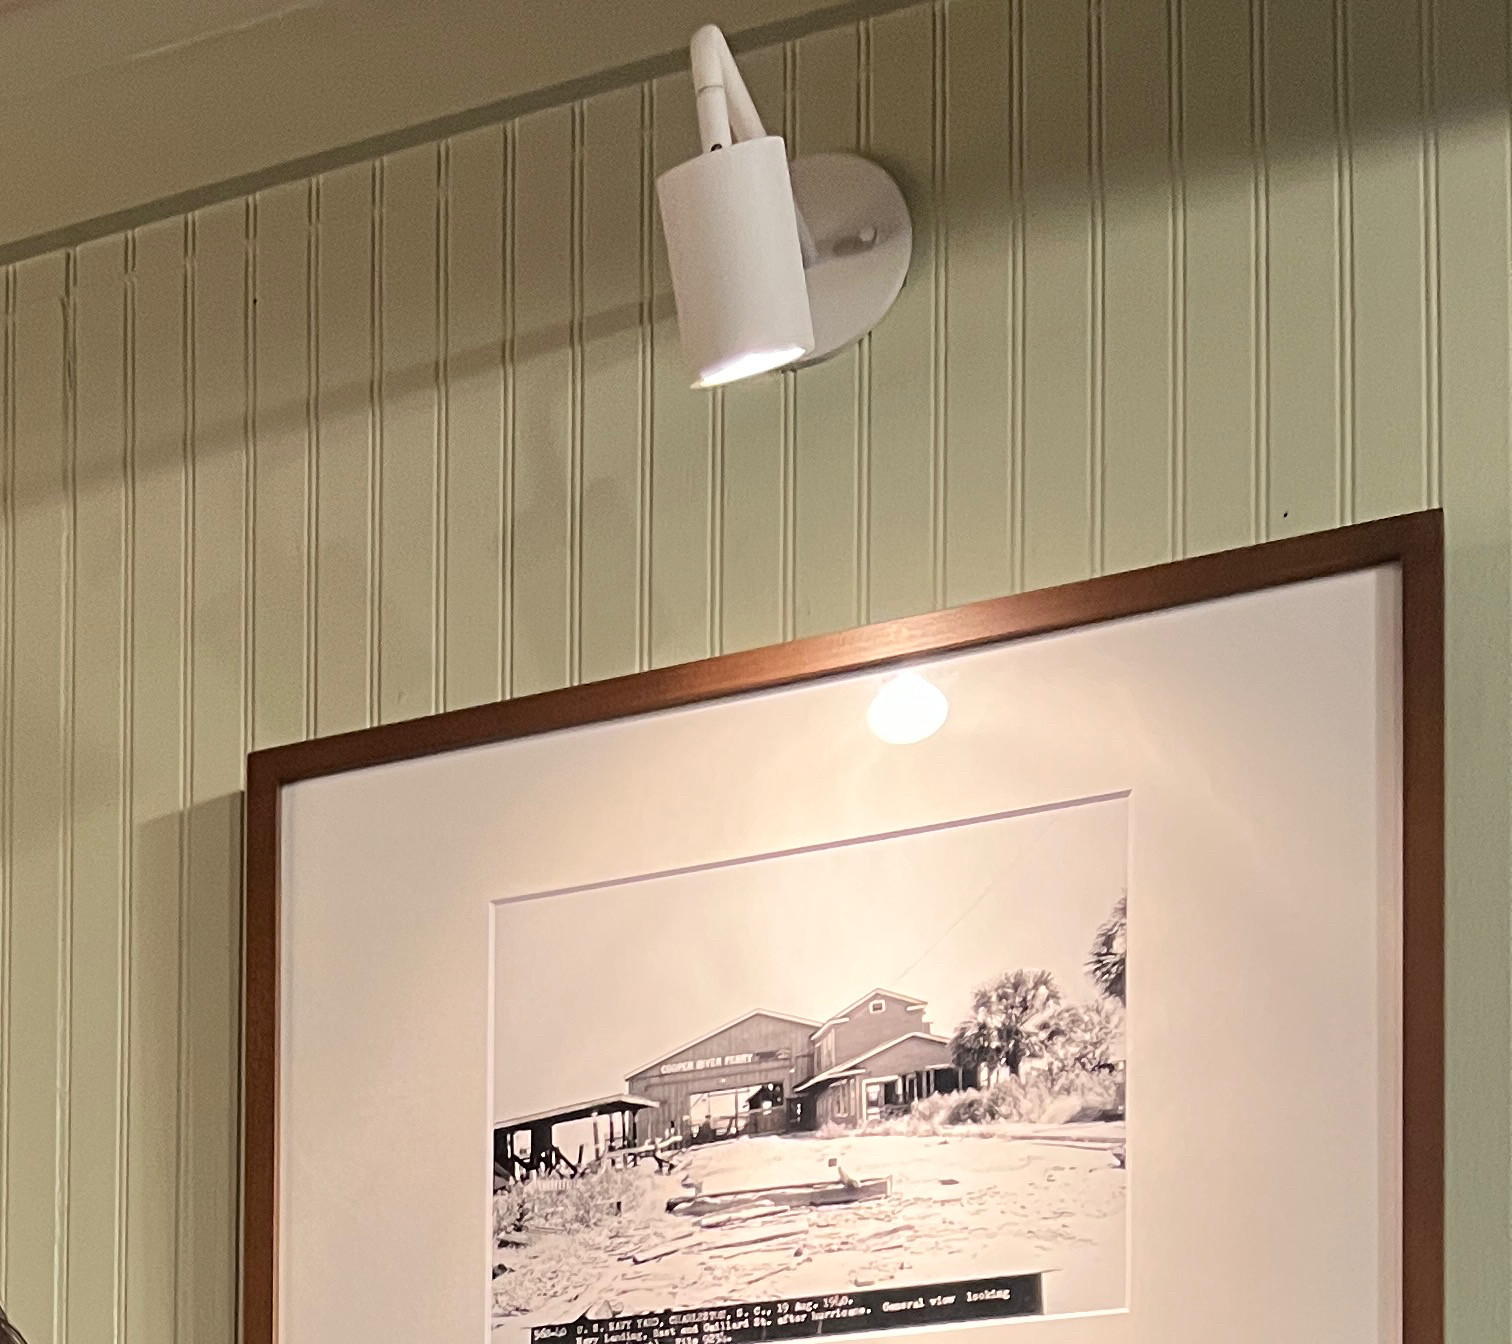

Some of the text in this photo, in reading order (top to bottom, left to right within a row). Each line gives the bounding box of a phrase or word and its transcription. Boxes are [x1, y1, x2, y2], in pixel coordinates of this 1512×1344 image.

[882, 1298, 925, 1312] General
[929, 1294, 956, 1306] view
[966, 1288, 1011, 1302] looking
[608, 1321, 632, 1331] NAVY
